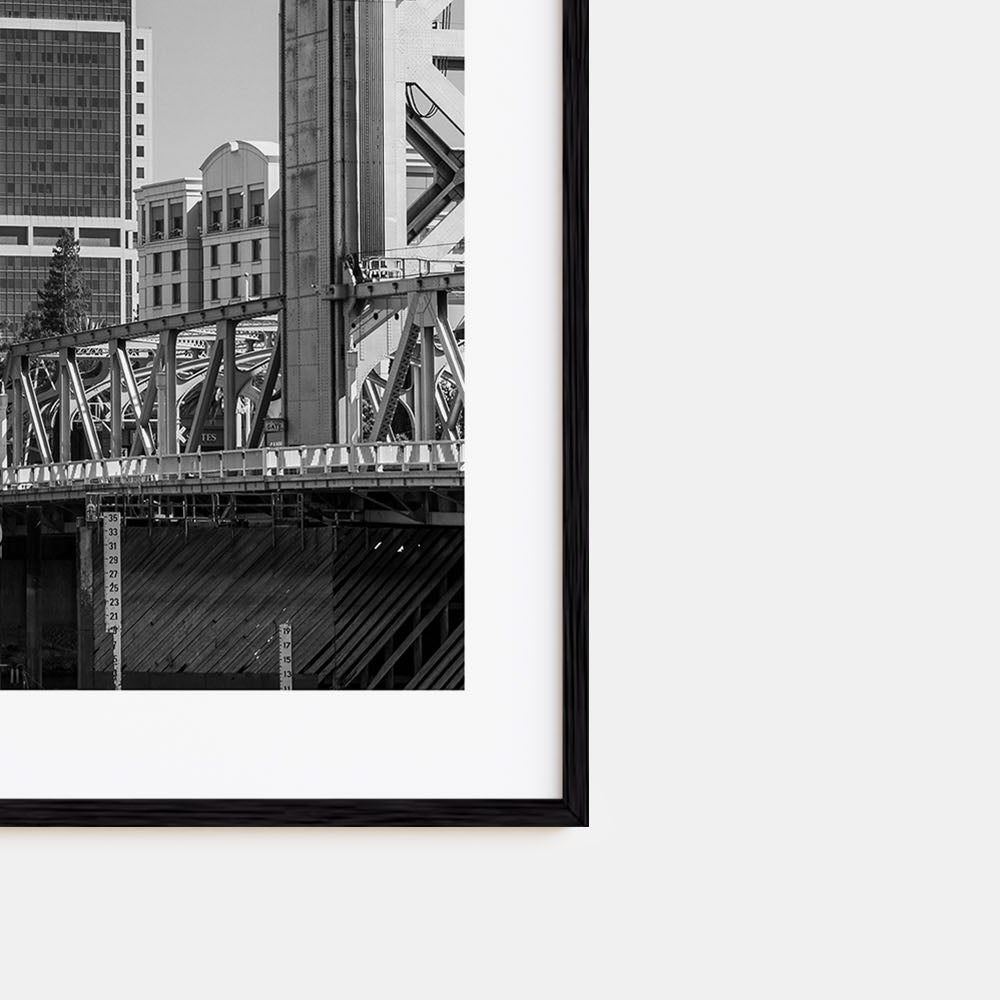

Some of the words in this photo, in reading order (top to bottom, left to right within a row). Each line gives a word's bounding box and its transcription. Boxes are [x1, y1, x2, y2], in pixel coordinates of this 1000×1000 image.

[108, 513, 118, 522] 35
[108, 527, 118, 536] 33
[108, 542, 117, 550] 31
[109, 556, 118, 564] 29
[109, 569, 118, 578] 27
[109, 582, 119, 592] 25
[109, 598, 119, 606] 23
[110, 612, 118, 620] 21
